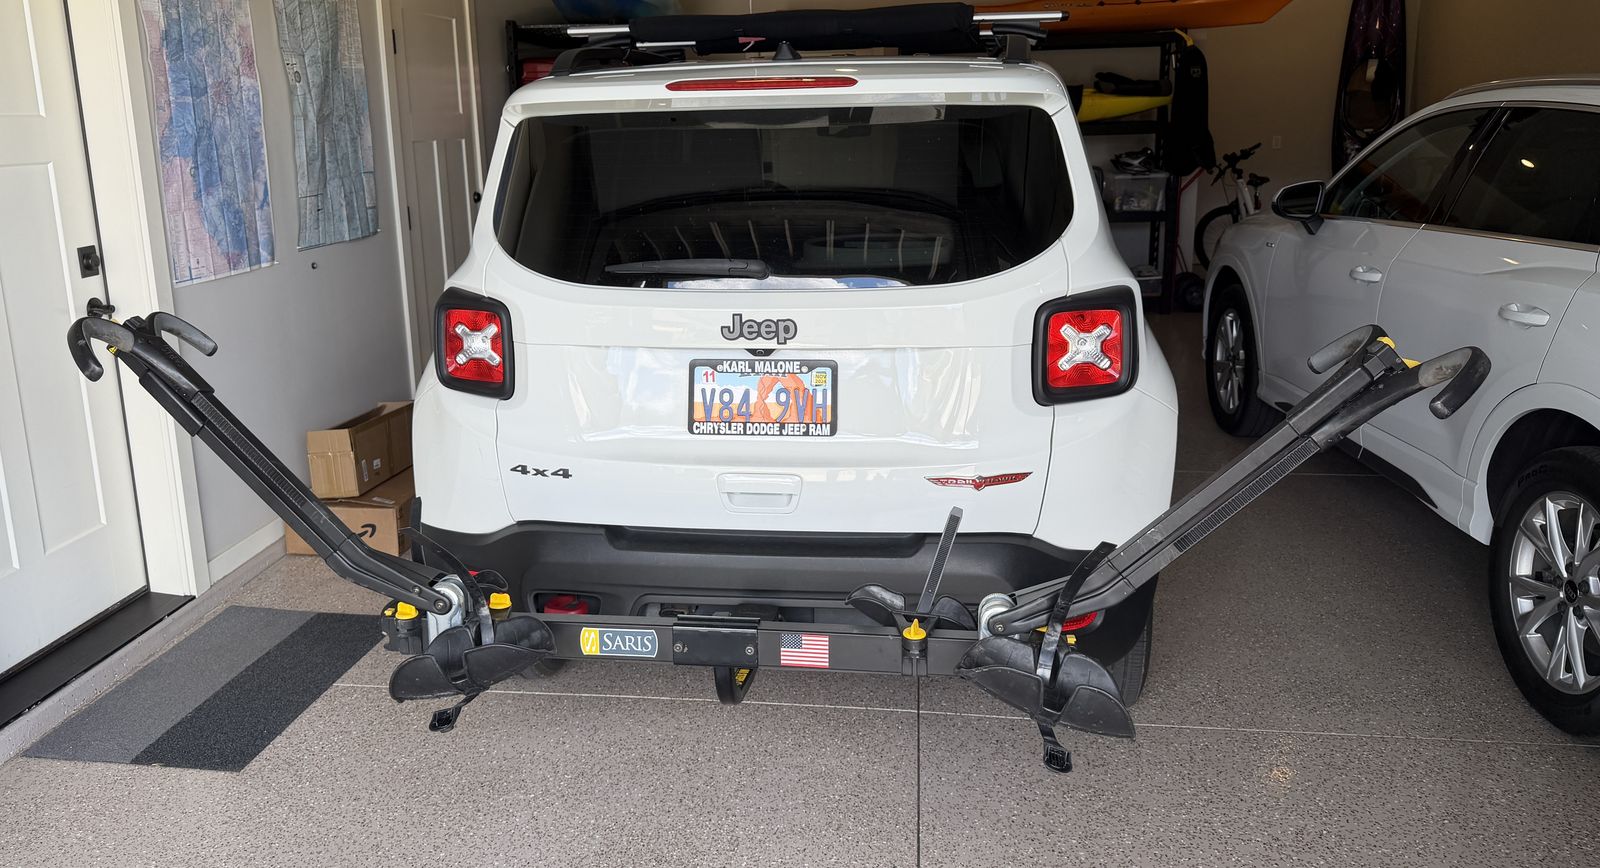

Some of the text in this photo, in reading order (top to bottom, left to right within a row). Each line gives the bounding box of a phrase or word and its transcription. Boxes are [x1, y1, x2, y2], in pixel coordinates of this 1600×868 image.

[721, 313, 797, 344] Jeep
[723, 361, 801, 374] KARL MALONE
[702, 370, 716, 383] 11
[700, 387, 828, 423] V84 9VH
[692, 422, 831, 436] CHRYSLER DODGE JEEP RAM
[510, 464, 572, 479] 4x4
[602, 632, 652, 652] SARIS
